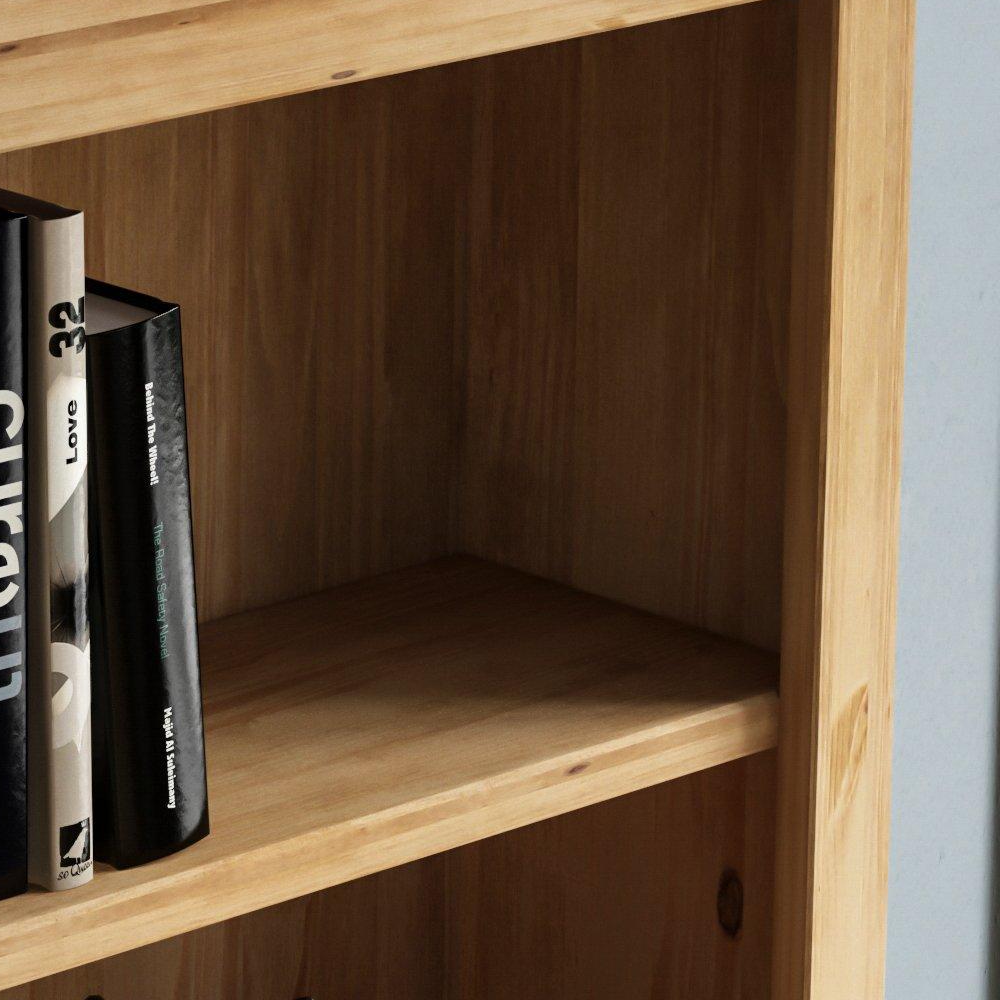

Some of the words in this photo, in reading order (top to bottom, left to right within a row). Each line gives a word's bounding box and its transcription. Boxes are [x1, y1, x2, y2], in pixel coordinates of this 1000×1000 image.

[48, 296, 86, 358] 32
[144, 381, 155, 422] Behind
[65, 399, 79, 465] Love
[147, 423, 156, 444] The
[148, 445, 159, 486] Wheel!
[153, 521, 164, 546] The
[154, 548, 166, 580] Road
[156, 582, 168, 623] Safety
[159, 624, 170, 660] Novel
